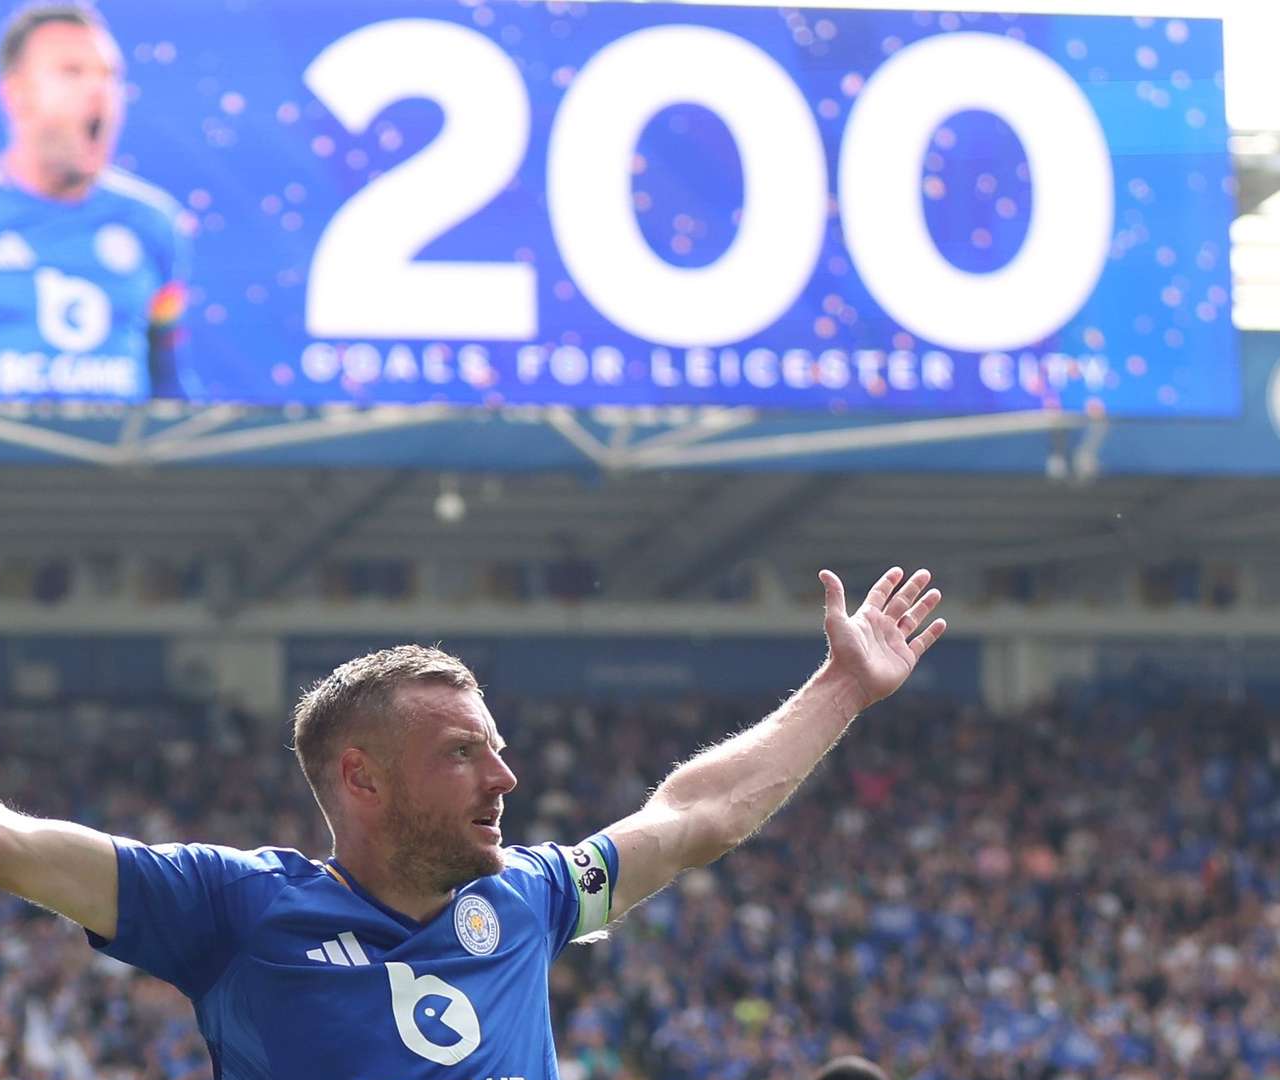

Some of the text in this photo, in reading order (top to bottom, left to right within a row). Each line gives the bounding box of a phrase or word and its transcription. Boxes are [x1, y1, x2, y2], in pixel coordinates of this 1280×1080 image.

[303, 18, 1115, 353] 200
[301, 341, 1110, 393] GOALS FOR LEICESTER CITY
